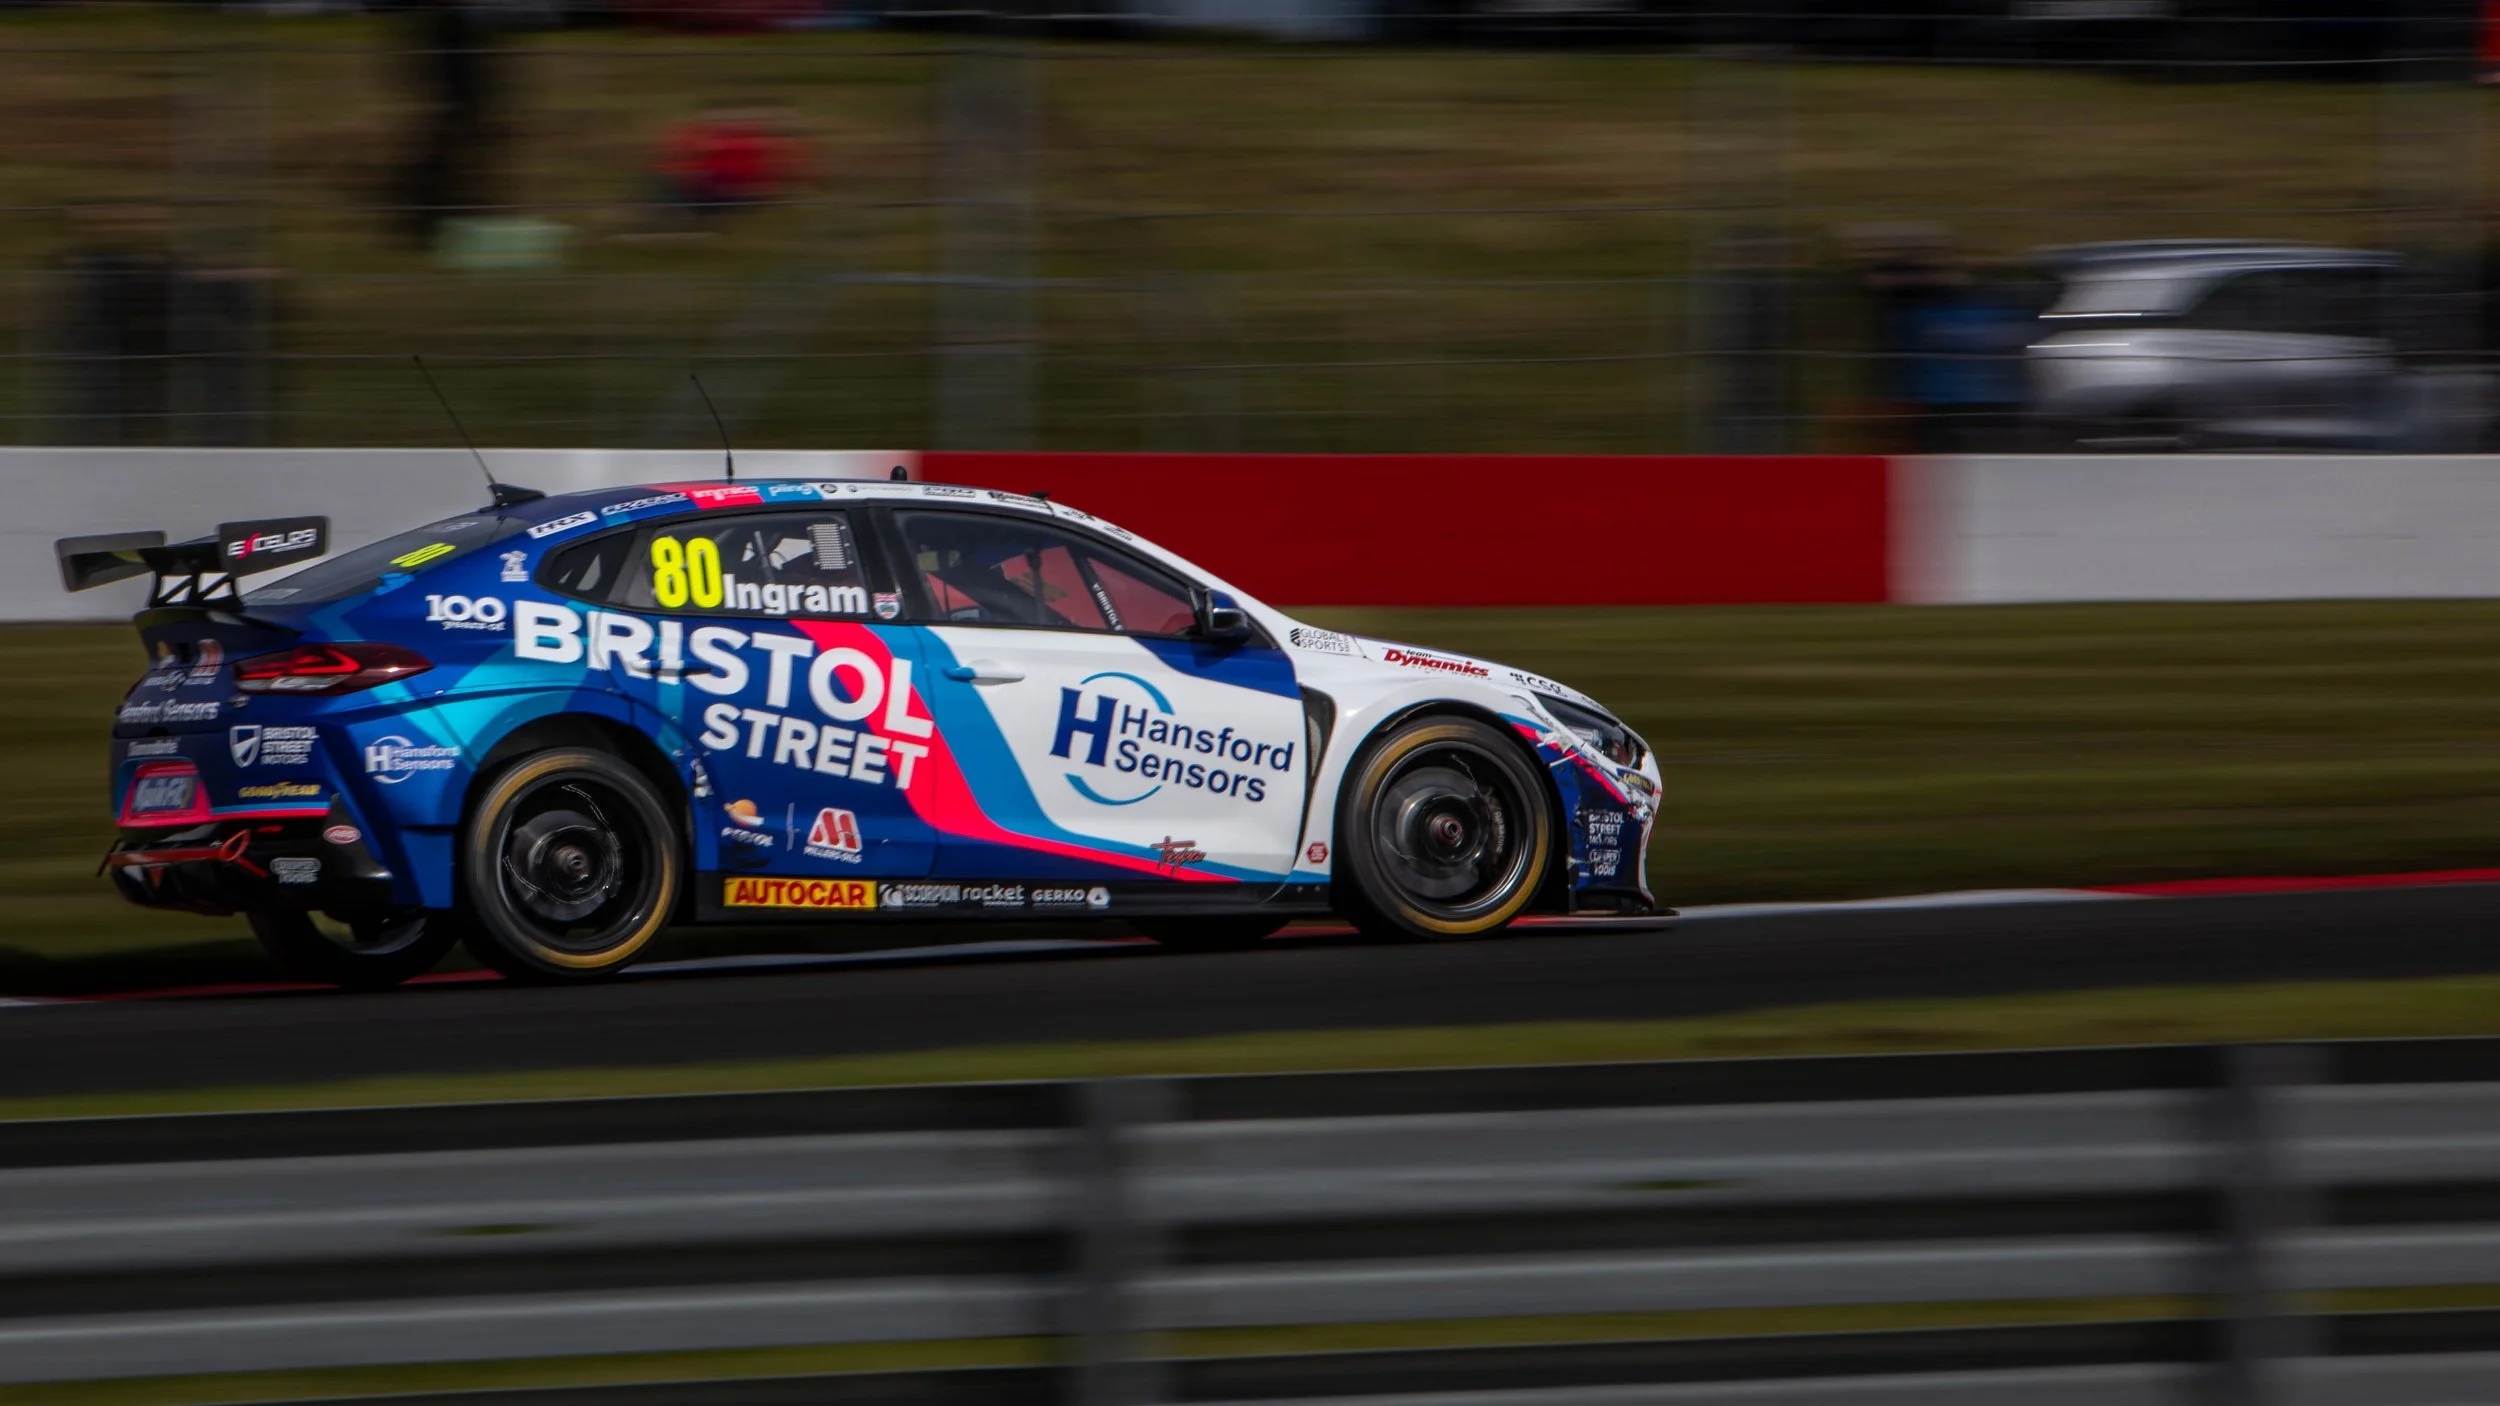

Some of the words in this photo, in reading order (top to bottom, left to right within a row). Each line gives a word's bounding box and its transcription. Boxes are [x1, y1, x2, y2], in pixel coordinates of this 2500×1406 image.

[651, 536, 724, 608] 80
[723, 573, 869, 615] Ingram
[425, 594, 507, 623] 100
[1300, 628, 1341, 642] GLOBAL
[1300, 639, 1345, 653] SPORTS
[1384, 649, 1489, 677] Dynamics
[1406, 649, 1432, 659] team
[513, 600, 935, 739] BRISTOL
[262, 726, 320, 739] BRISTOL
[1049, 686, 1119, 767] H
[261, 740, 314, 753] STREET
[700, 703, 930, 790] STREET
[1119, 704, 1295, 772] Hansford
[390, 744, 460, 758] Hansford
[390, 757, 455, 771] Sensors
[1114, 739, 1267, 803] Sensors
[734, 879, 867, 906] AUTOCAR
[962, 884, 1025, 902] rocket
[1031, 888, 1086, 903] GERKO
